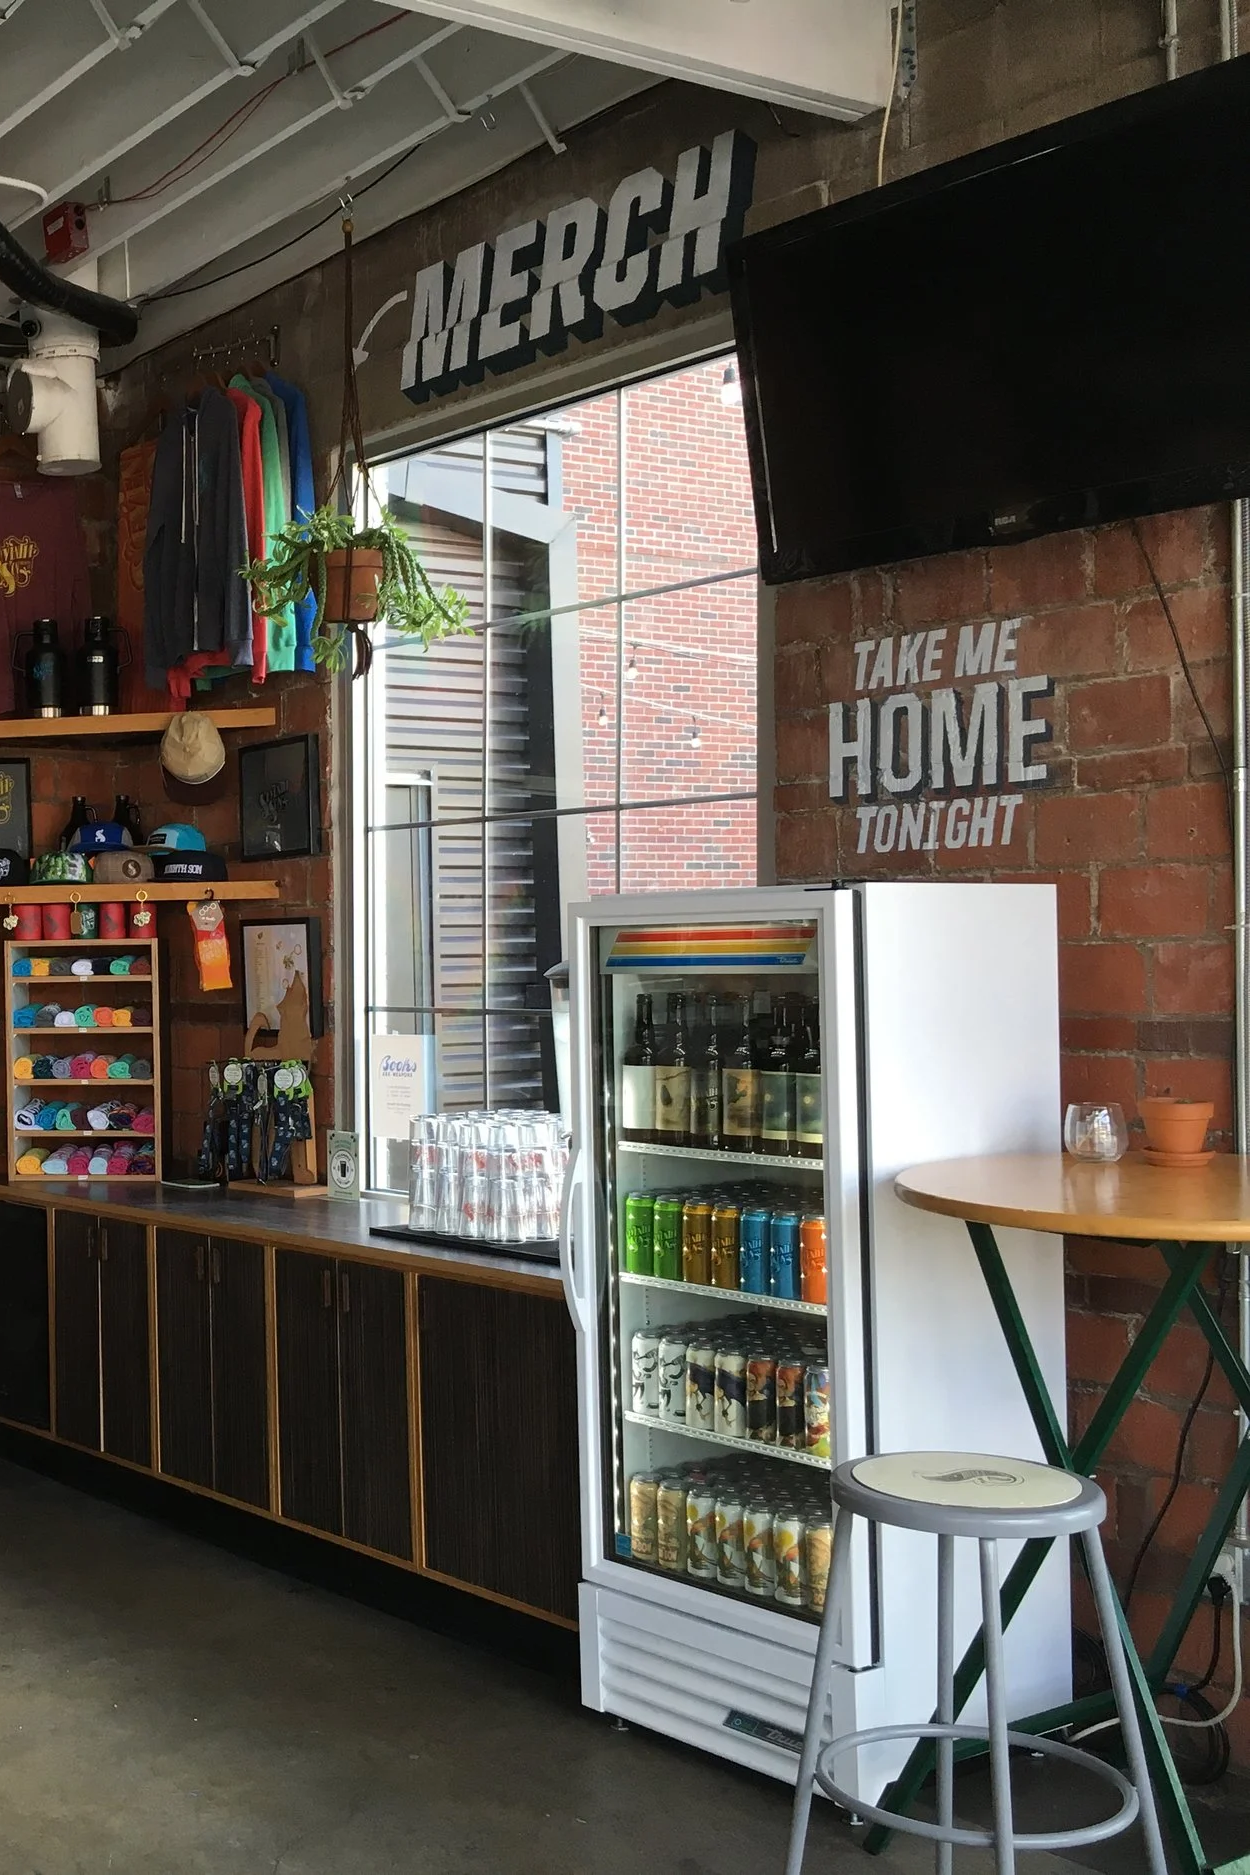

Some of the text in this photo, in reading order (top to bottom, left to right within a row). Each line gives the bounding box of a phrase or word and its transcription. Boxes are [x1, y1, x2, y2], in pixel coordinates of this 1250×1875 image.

[400, 128, 742, 396] MERCH
[853, 618, 1022, 691] TAKE ME
[828, 674, 1053, 801] HOME
[855, 794, 1023, 855] TONIGHT
[379, 1055, 417, 1076] Books
